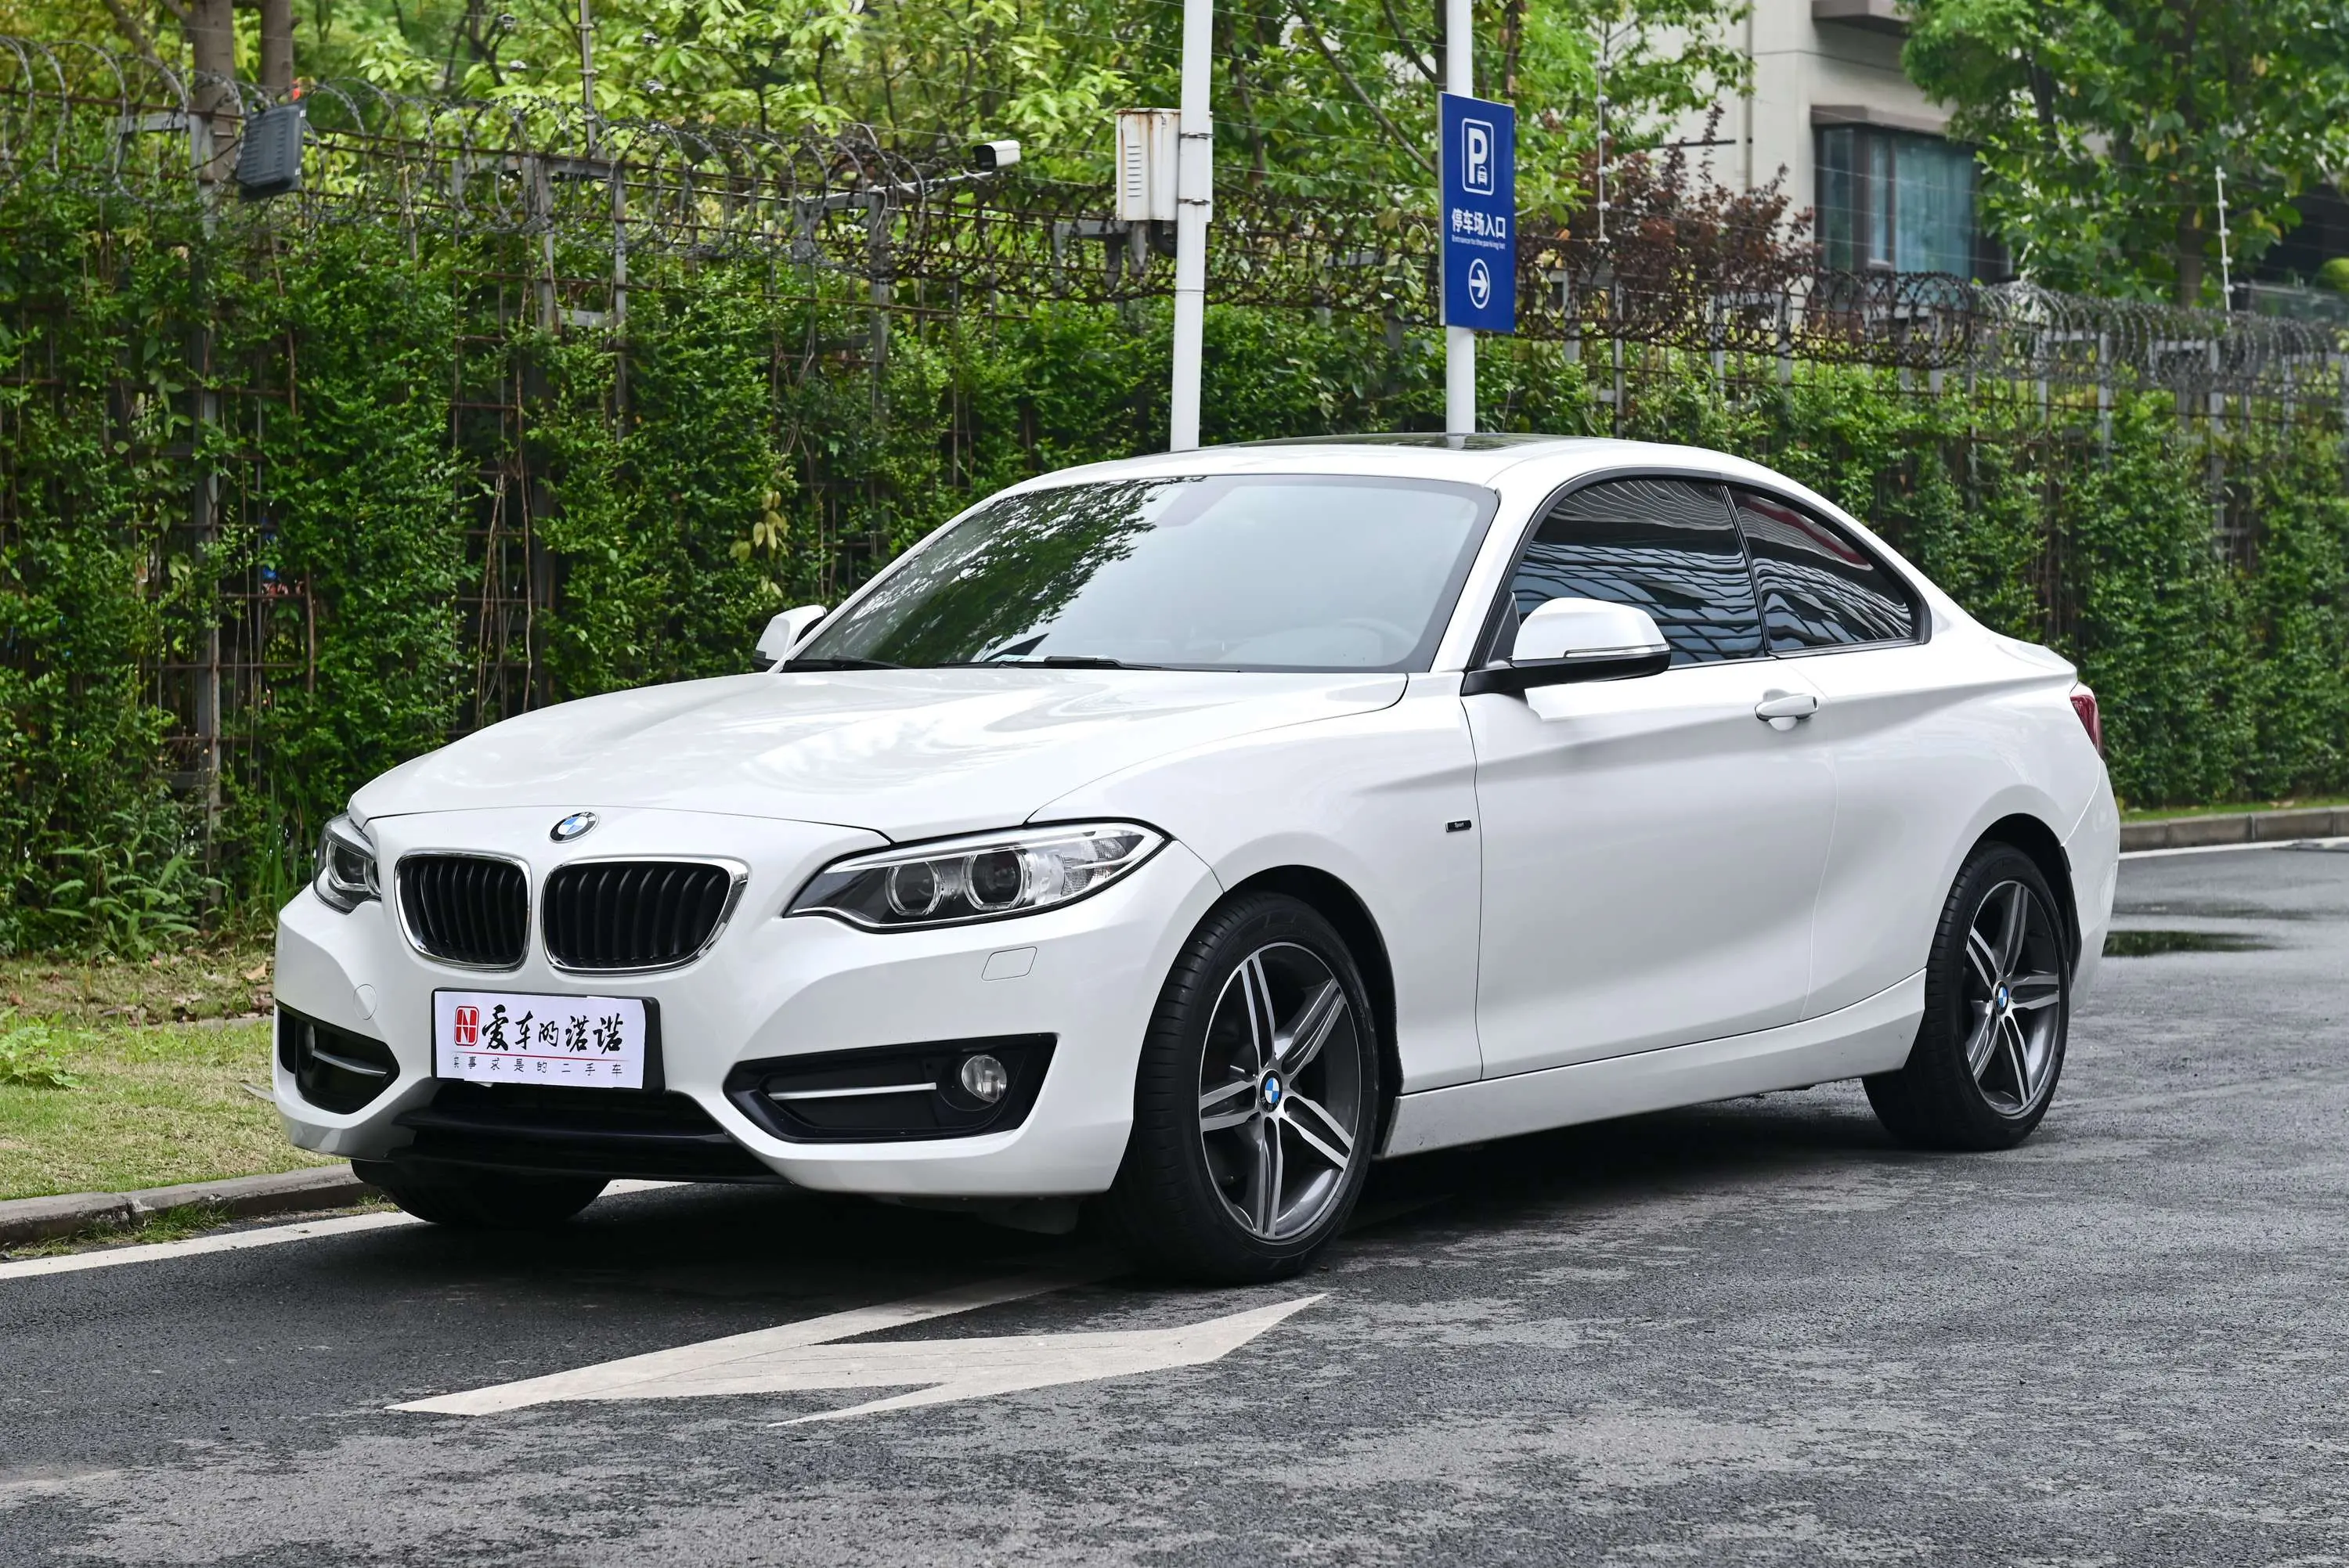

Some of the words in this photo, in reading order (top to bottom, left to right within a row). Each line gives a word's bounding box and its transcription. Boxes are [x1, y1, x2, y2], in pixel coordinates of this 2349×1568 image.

[1467, 127, 1488, 184] P
[1452, 207, 1506, 240] 停车场入口
